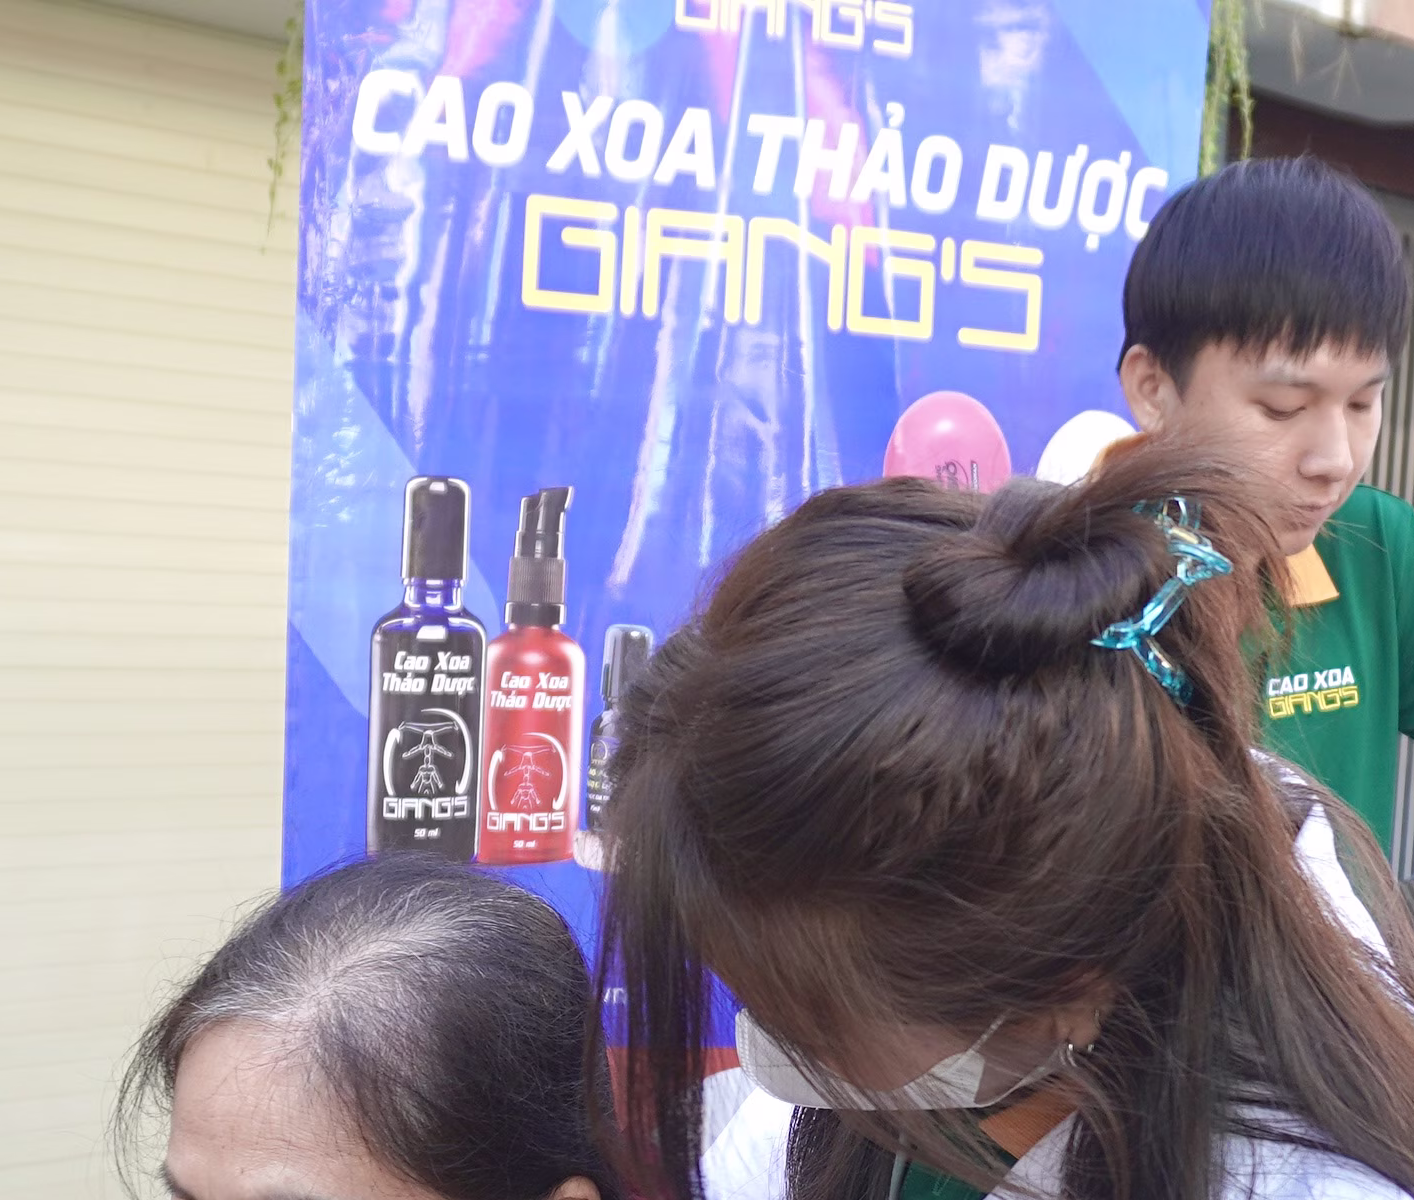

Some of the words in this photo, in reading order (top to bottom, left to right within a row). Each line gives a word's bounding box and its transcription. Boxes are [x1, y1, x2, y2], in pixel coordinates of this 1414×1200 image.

[352, 68, 534, 166] CAO
[547, 90, 716, 190] XOA
[742, 102, 962, 215] THẢO
[977, 144, 1168, 251] DƯỢC
[522, 195, 1044, 353] GIANG'S
[394, 651, 431, 671] Cao
[434, 651, 471, 671] Xoa
[383, 672, 425, 693] Thảo
[501, 672, 530, 689] Cao
[536, 673, 569, 689] Xoa
[1269, 673, 1309, 696] CAO
[1314, 666, 1355, 690] XOA
[490, 690, 526, 709] Thảo
[1269, 686, 1359, 718] GIANG'S
[383, 796, 468, 819] GIANG'S
[487, 812, 565, 831] GIANG'S
[414, 828, 427, 838] 50
